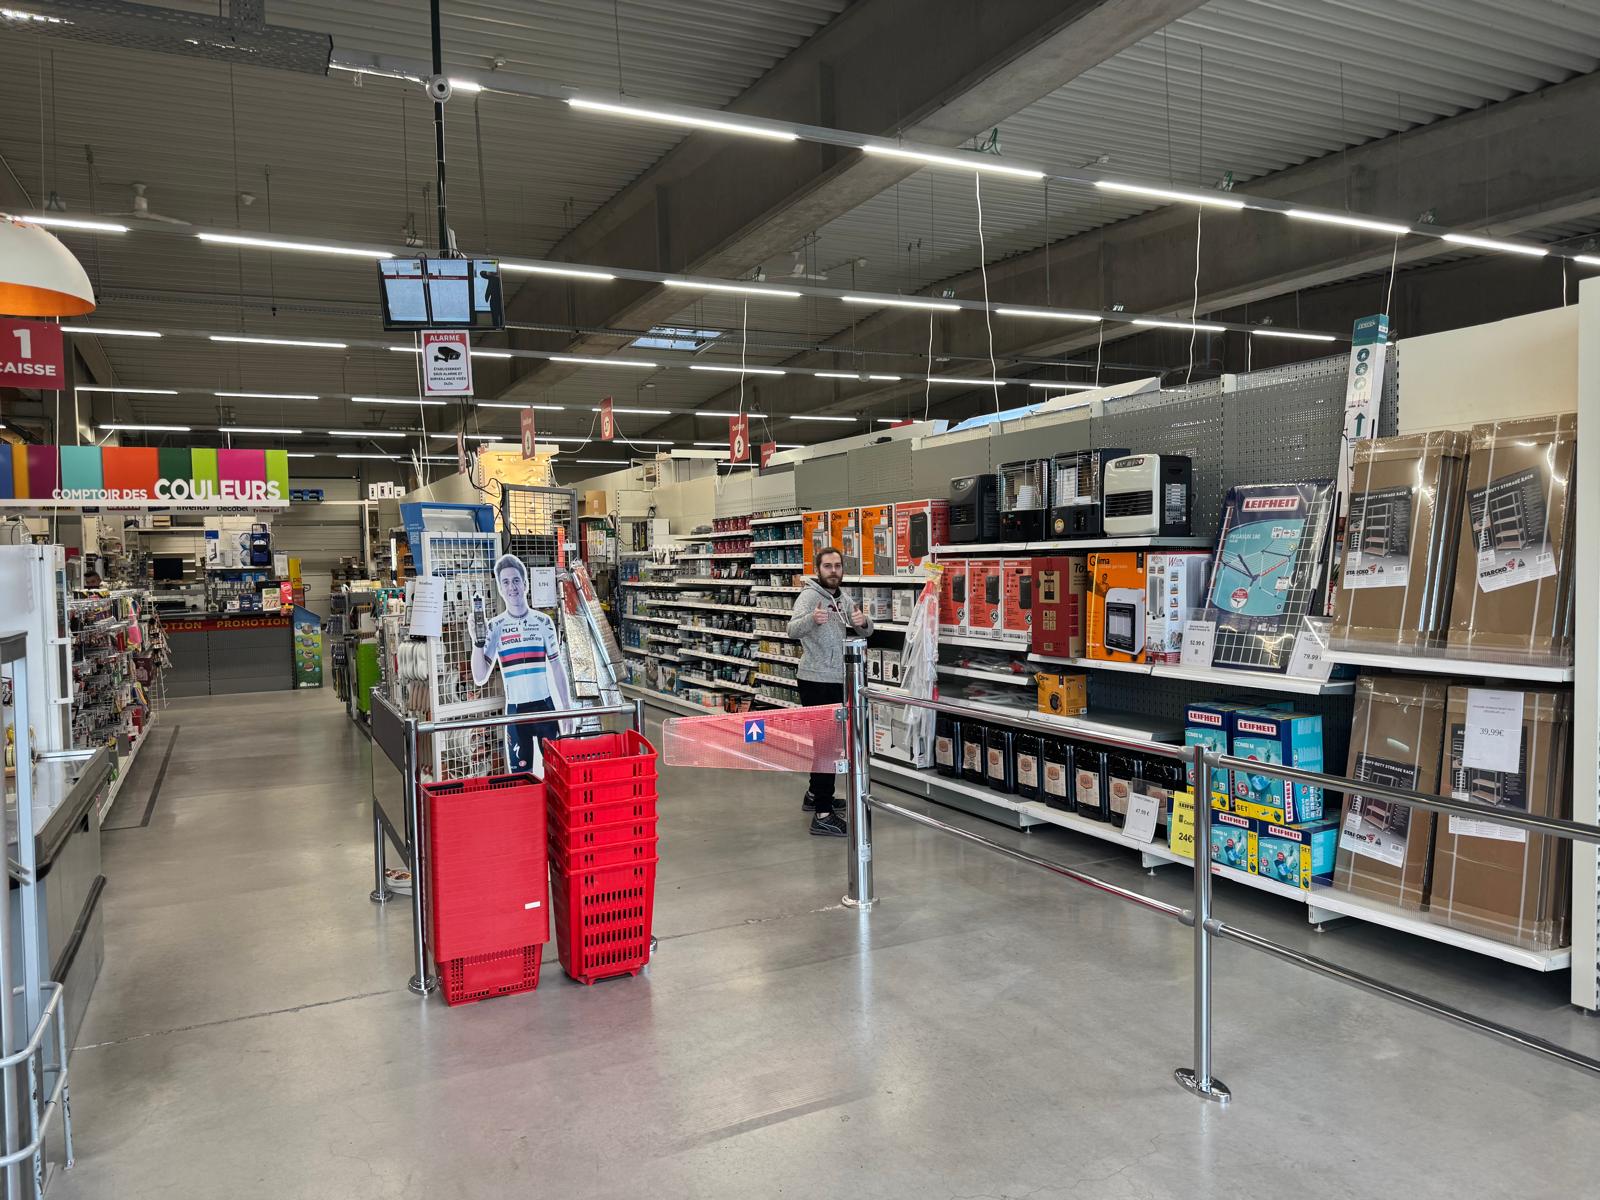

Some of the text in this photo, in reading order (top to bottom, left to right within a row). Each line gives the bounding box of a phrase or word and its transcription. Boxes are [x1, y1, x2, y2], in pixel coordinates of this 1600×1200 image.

[12, 328, 32, 359] 1
[736, 440, 742, 453] 2
[52, 478, 280, 501] COMPTOIR DES COULEURS
[1244, 498, 1298, 509] LEIFHEIT
[1480, 566, 1508, 578] STARCKO
[216, 618, 290, 628] PROMOTION
[1190, 712, 1221, 724] LEIFHEIT
[1240, 722, 1275, 733] LEIFHEIT
[1479, 727, 1505, 737] 39,99€
[1236, 804, 1248, 812] SET
[1220, 814, 1248, 826] LEIFHEIT
[1178, 832, 1194, 843] 24€
[1270, 827, 1300, 840] LEIFHEIT
